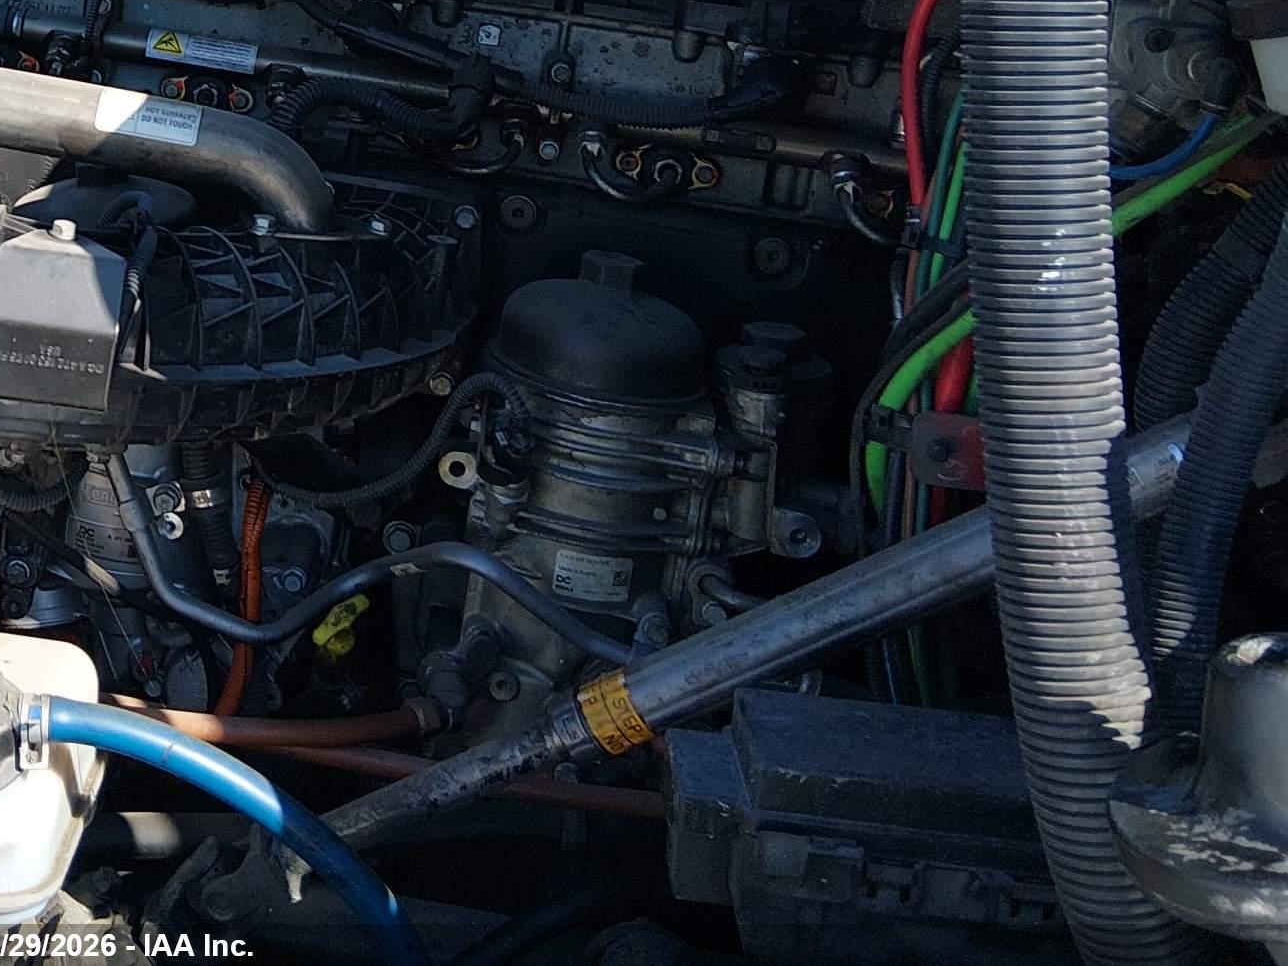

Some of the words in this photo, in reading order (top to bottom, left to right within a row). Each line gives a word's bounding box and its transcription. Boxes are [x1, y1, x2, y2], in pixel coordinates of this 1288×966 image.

[145, 106, 160, 114] HOT
[141, 114, 152, 122] DO
[153, 116, 168, 126] NOT
[169, 120, 193, 130] TOUCH
